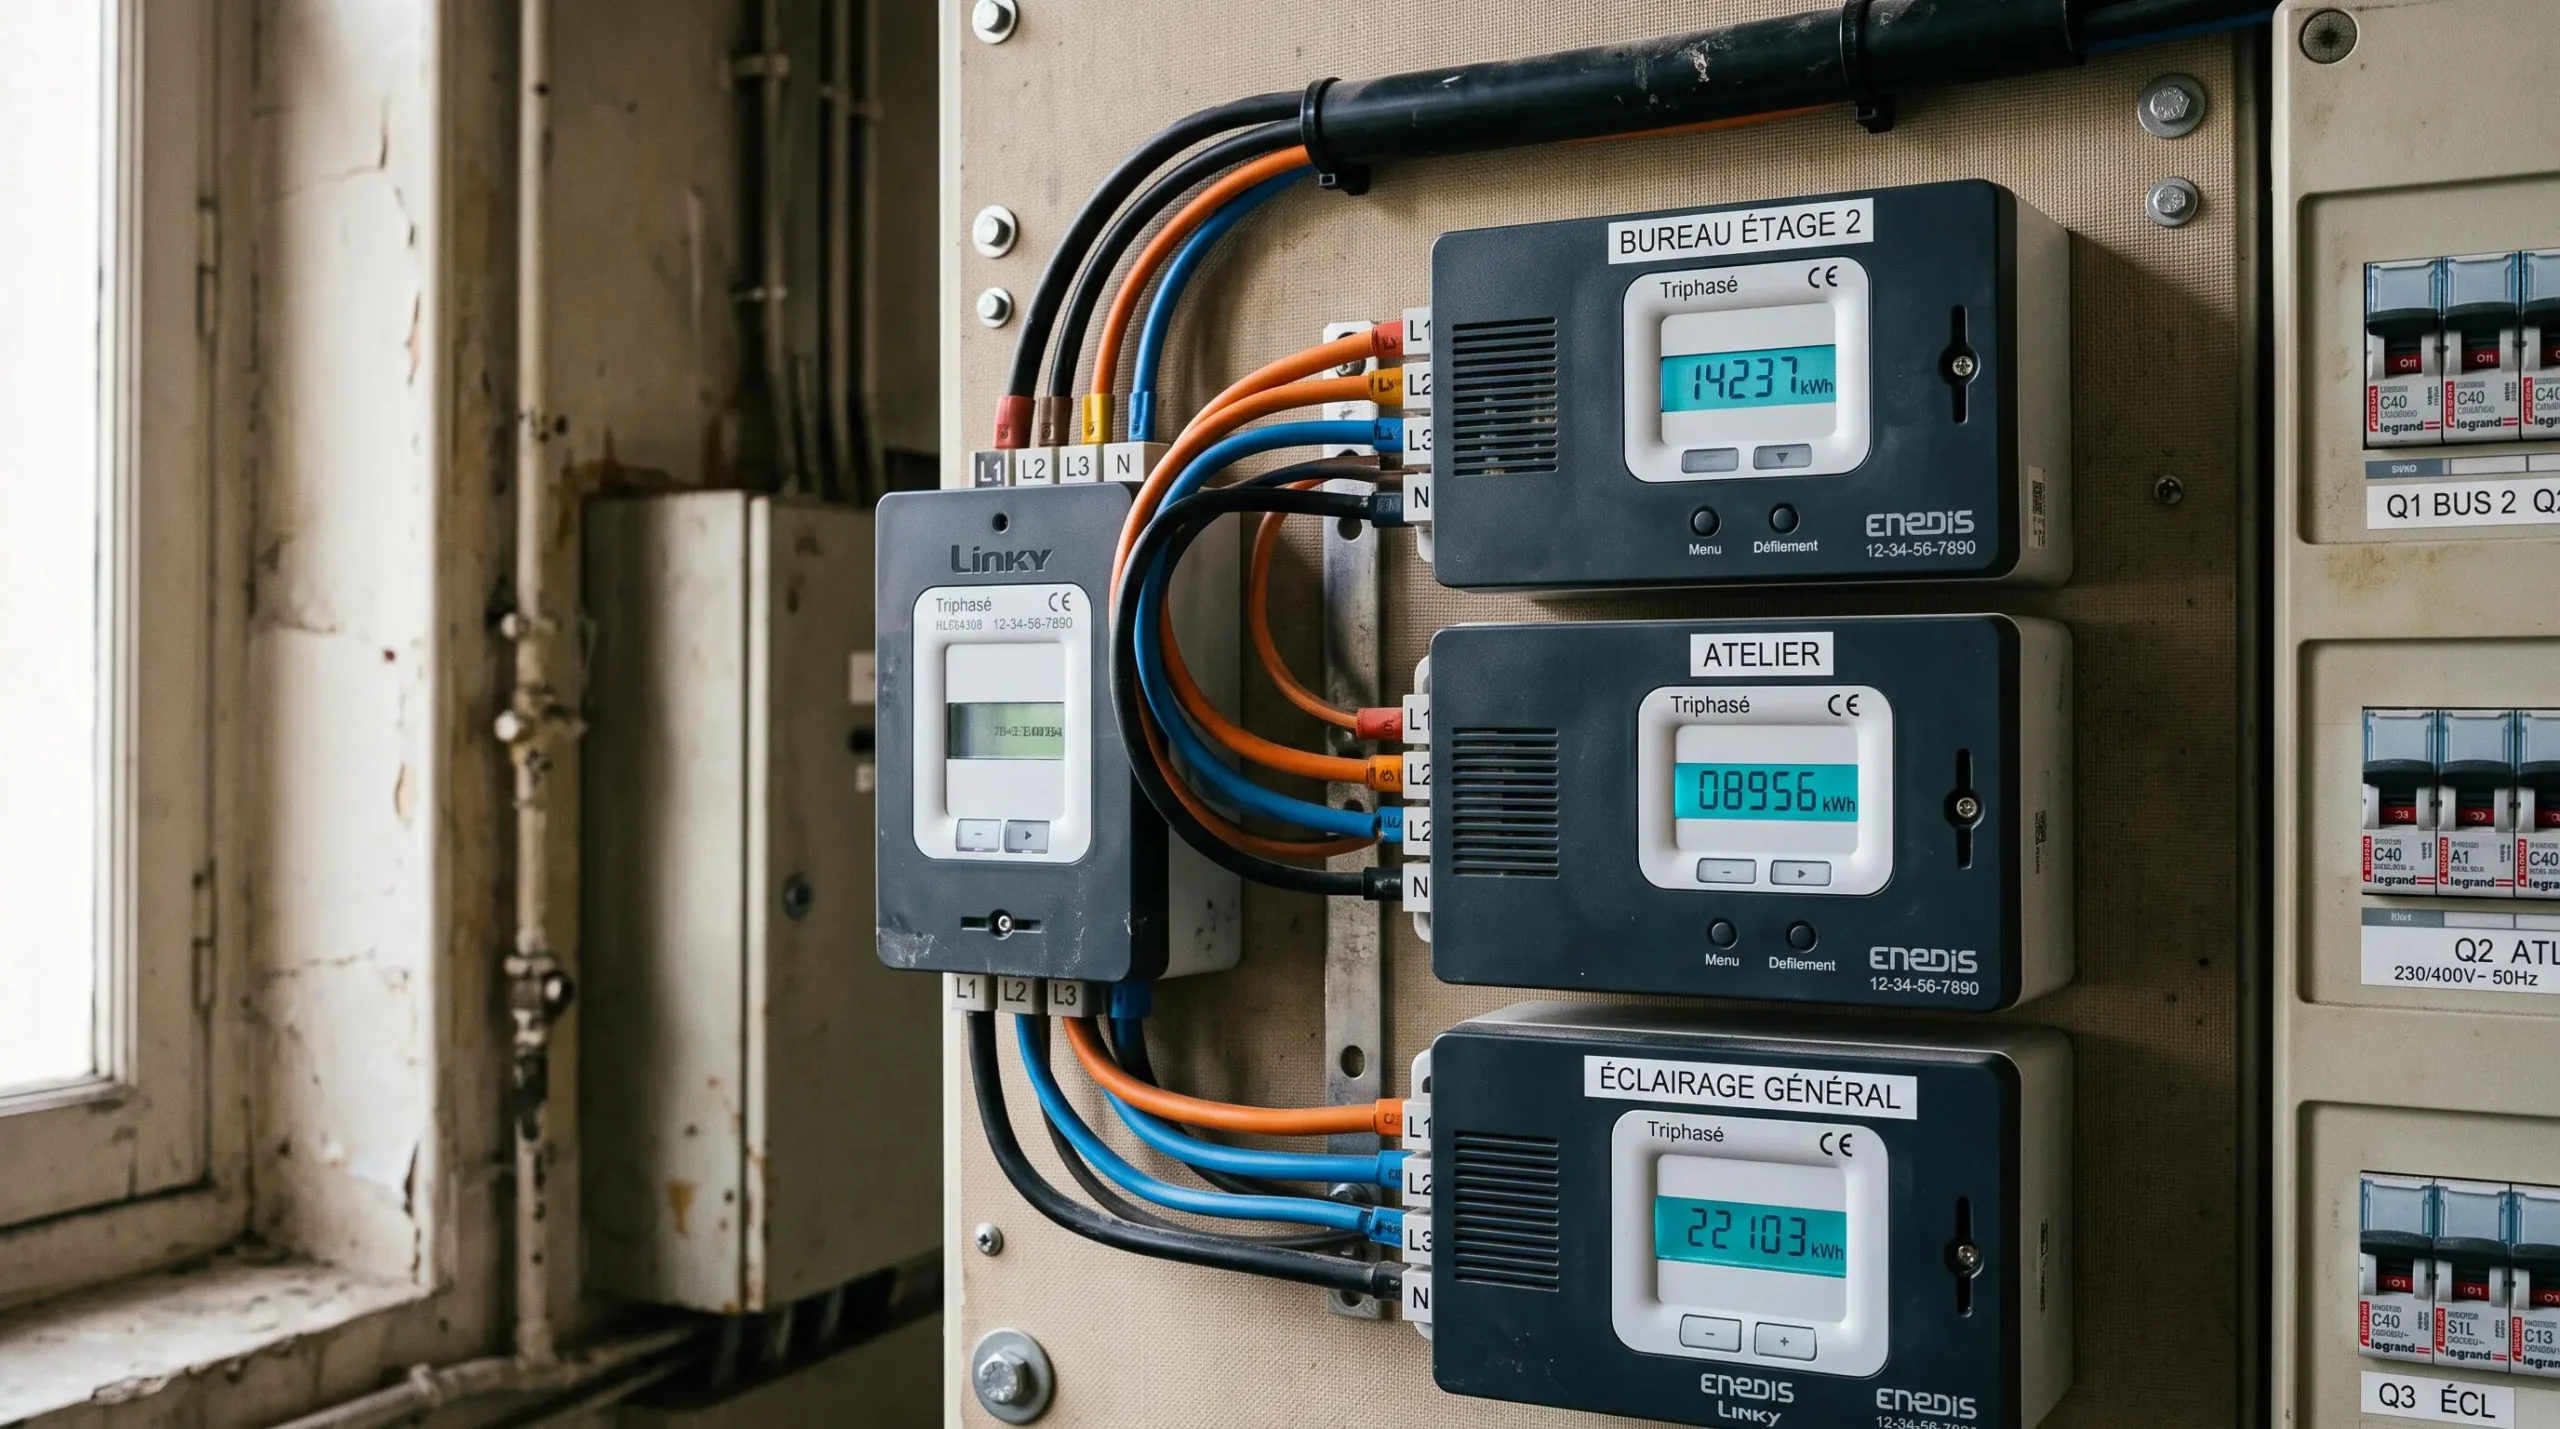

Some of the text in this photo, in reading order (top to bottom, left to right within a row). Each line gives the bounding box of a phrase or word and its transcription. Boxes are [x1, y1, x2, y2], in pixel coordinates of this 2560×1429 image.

[1620, 209, 1861, 254] BUREAU ÉTAGE 2
[1660, 275, 1738, 301] Triphasé
[1410, 319, 1431, 341] L1
[1409, 373, 1431, 396] L2
[1693, 356, 1834, 400] 14237 kWh
[2380, 395, 2407, 410] C40
[2457, 391, 2485, 405] C40
[2380, 421, 2424, 435] legrand
[2456, 417, 2501, 431] legrand
[980, 453, 1130, 482] L1 L2 L3 N
[1414, 486, 1429, 509] N
[2387, 493, 2420, 519] Q1
[2434, 491, 2492, 517] BUS
[2501, 490, 2516, 514] 2
[1689, 543, 1722, 556] Menu
[1753, 540, 1818, 554] Défilement
[1866, 541, 1976, 557] 12-34-56-7890
[935, 596, 992, 616] Triphasé
[993, 617, 1073, 630] 12-34-56-7890
[1703, 641, 1821, 667] ATELIER
[1670, 695, 1750, 717] Triphasé
[1410, 708, 1430, 730] L1
[1409, 764, 1430, 785] L2
[1699, 770, 1856, 813] 08956 kWh
[1409, 820, 1430, 842] L2
[2374, 847, 2402, 862] C40
[2450, 850, 2469, 865] A1
[2529, 851, 2559, 866] C40
[1413, 876, 1428, 898] N
[2374, 874, 2416, 886] legrand
[2450, 876, 2495, 890] legrand
[2455, 937, 2494, 963] Q2
[1705, 954, 1740, 967] Menu
[1769, 956, 1836, 972] Defilement
[1870, 977, 1979, 996] 12-34-56-7890
[2493, 969, 2538, 986] 50Hz
[957, 977, 1076, 1006] L1 L2 L3
[1600, 1061, 1901, 1109] ÉCLAIRAGE GÉNÉRAL
[1409, 1115, 1431, 1139] L1
[1647, 1120, 1724, 1143] Triphasé
[1409, 1172, 1432, 1195] L2
[1811, 1242, 1844, 1261] kWh
[1413, 1286, 1429, 1310] N
[2371, 1313, 2400, 1329] C40
[2448, 1319, 2474, 1336] S1L
[2371, 1338, 2416, 1353] legrand
[2524, 1328, 2553, 1344] C13
[2445, 1346, 2491, 1362] legrand
[2379, 1382, 2496, 1419] Q3 ÉCL
